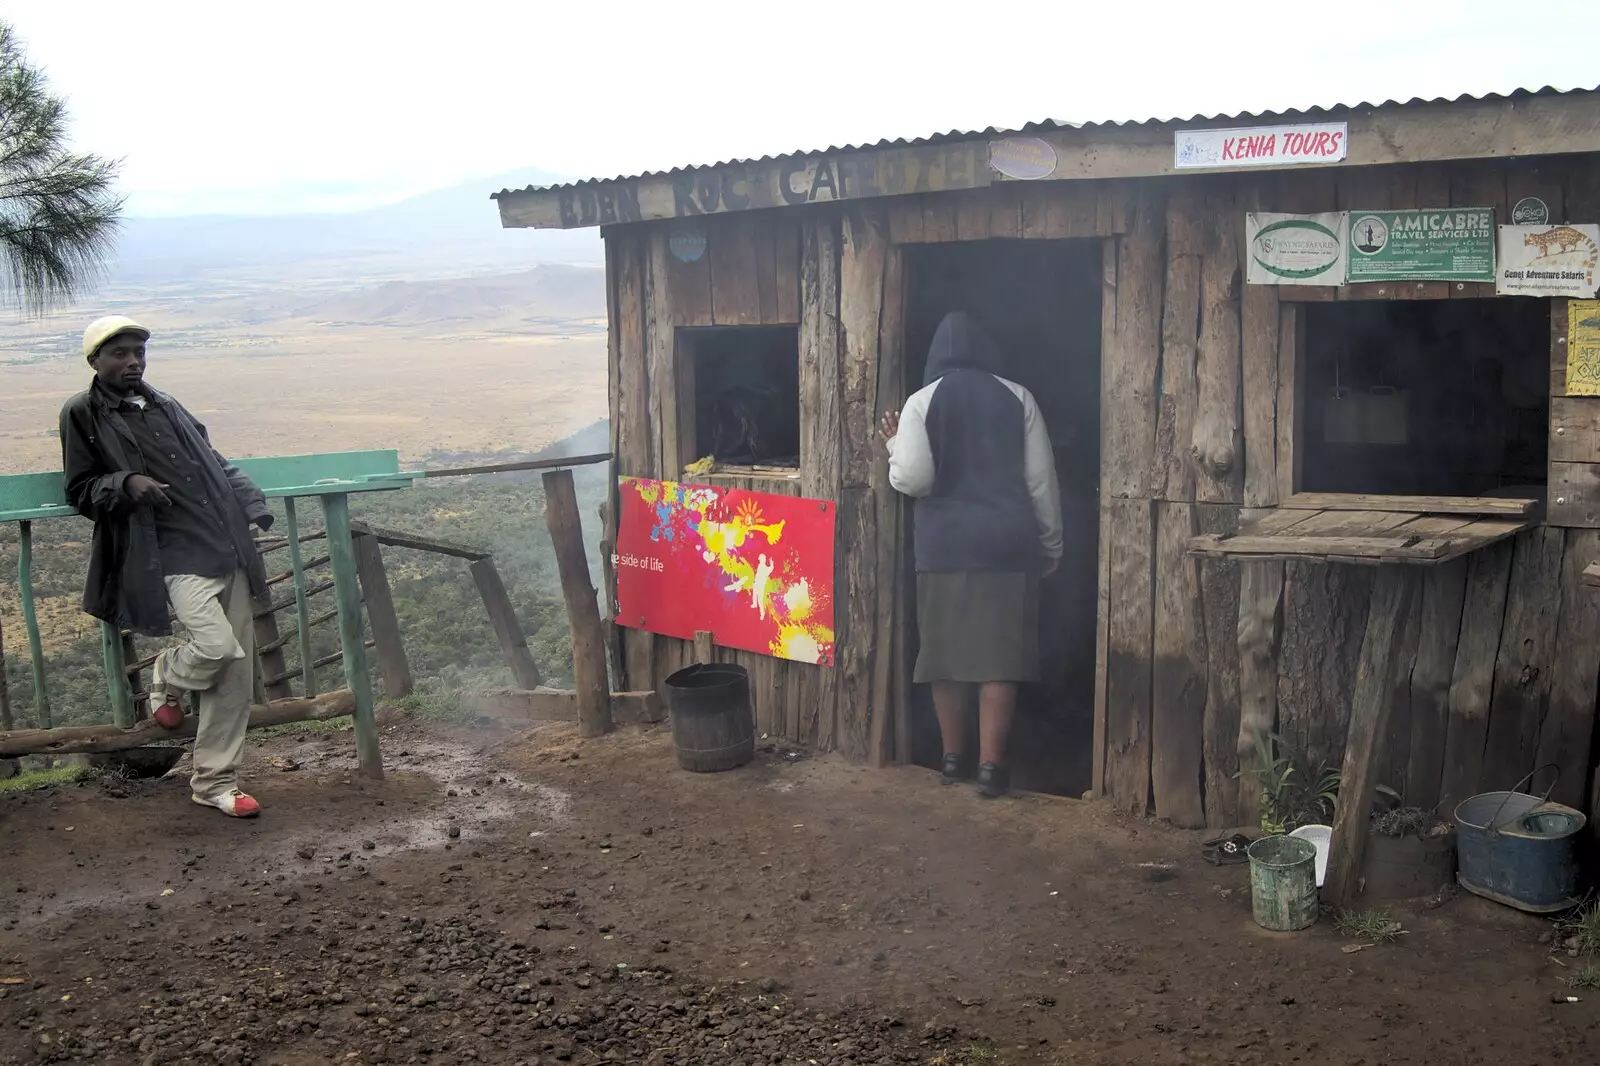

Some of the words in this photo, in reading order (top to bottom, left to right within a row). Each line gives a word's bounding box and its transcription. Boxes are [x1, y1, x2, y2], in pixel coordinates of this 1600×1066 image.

[1222, 134, 1276, 161] KENIA
[1282, 131, 1343, 157] TOURS
[560, 186, 643, 226] EDEN
[1391, 213, 1490, 231] AMICABRE
[1391, 231, 1425, 240] TRAVEL
[1428, 230, 1469, 239] SERVICES
[1472, 229, 1490, 238] LTD
[1504, 270, 1524, 279] Genet
[1526, 270, 1560, 280] Adventure
[1561, 271, 1585, 280] Safaris
[621, 553, 638, 567] side
[640, 556, 649, 569] of
[650, 557, 664, 572] life
